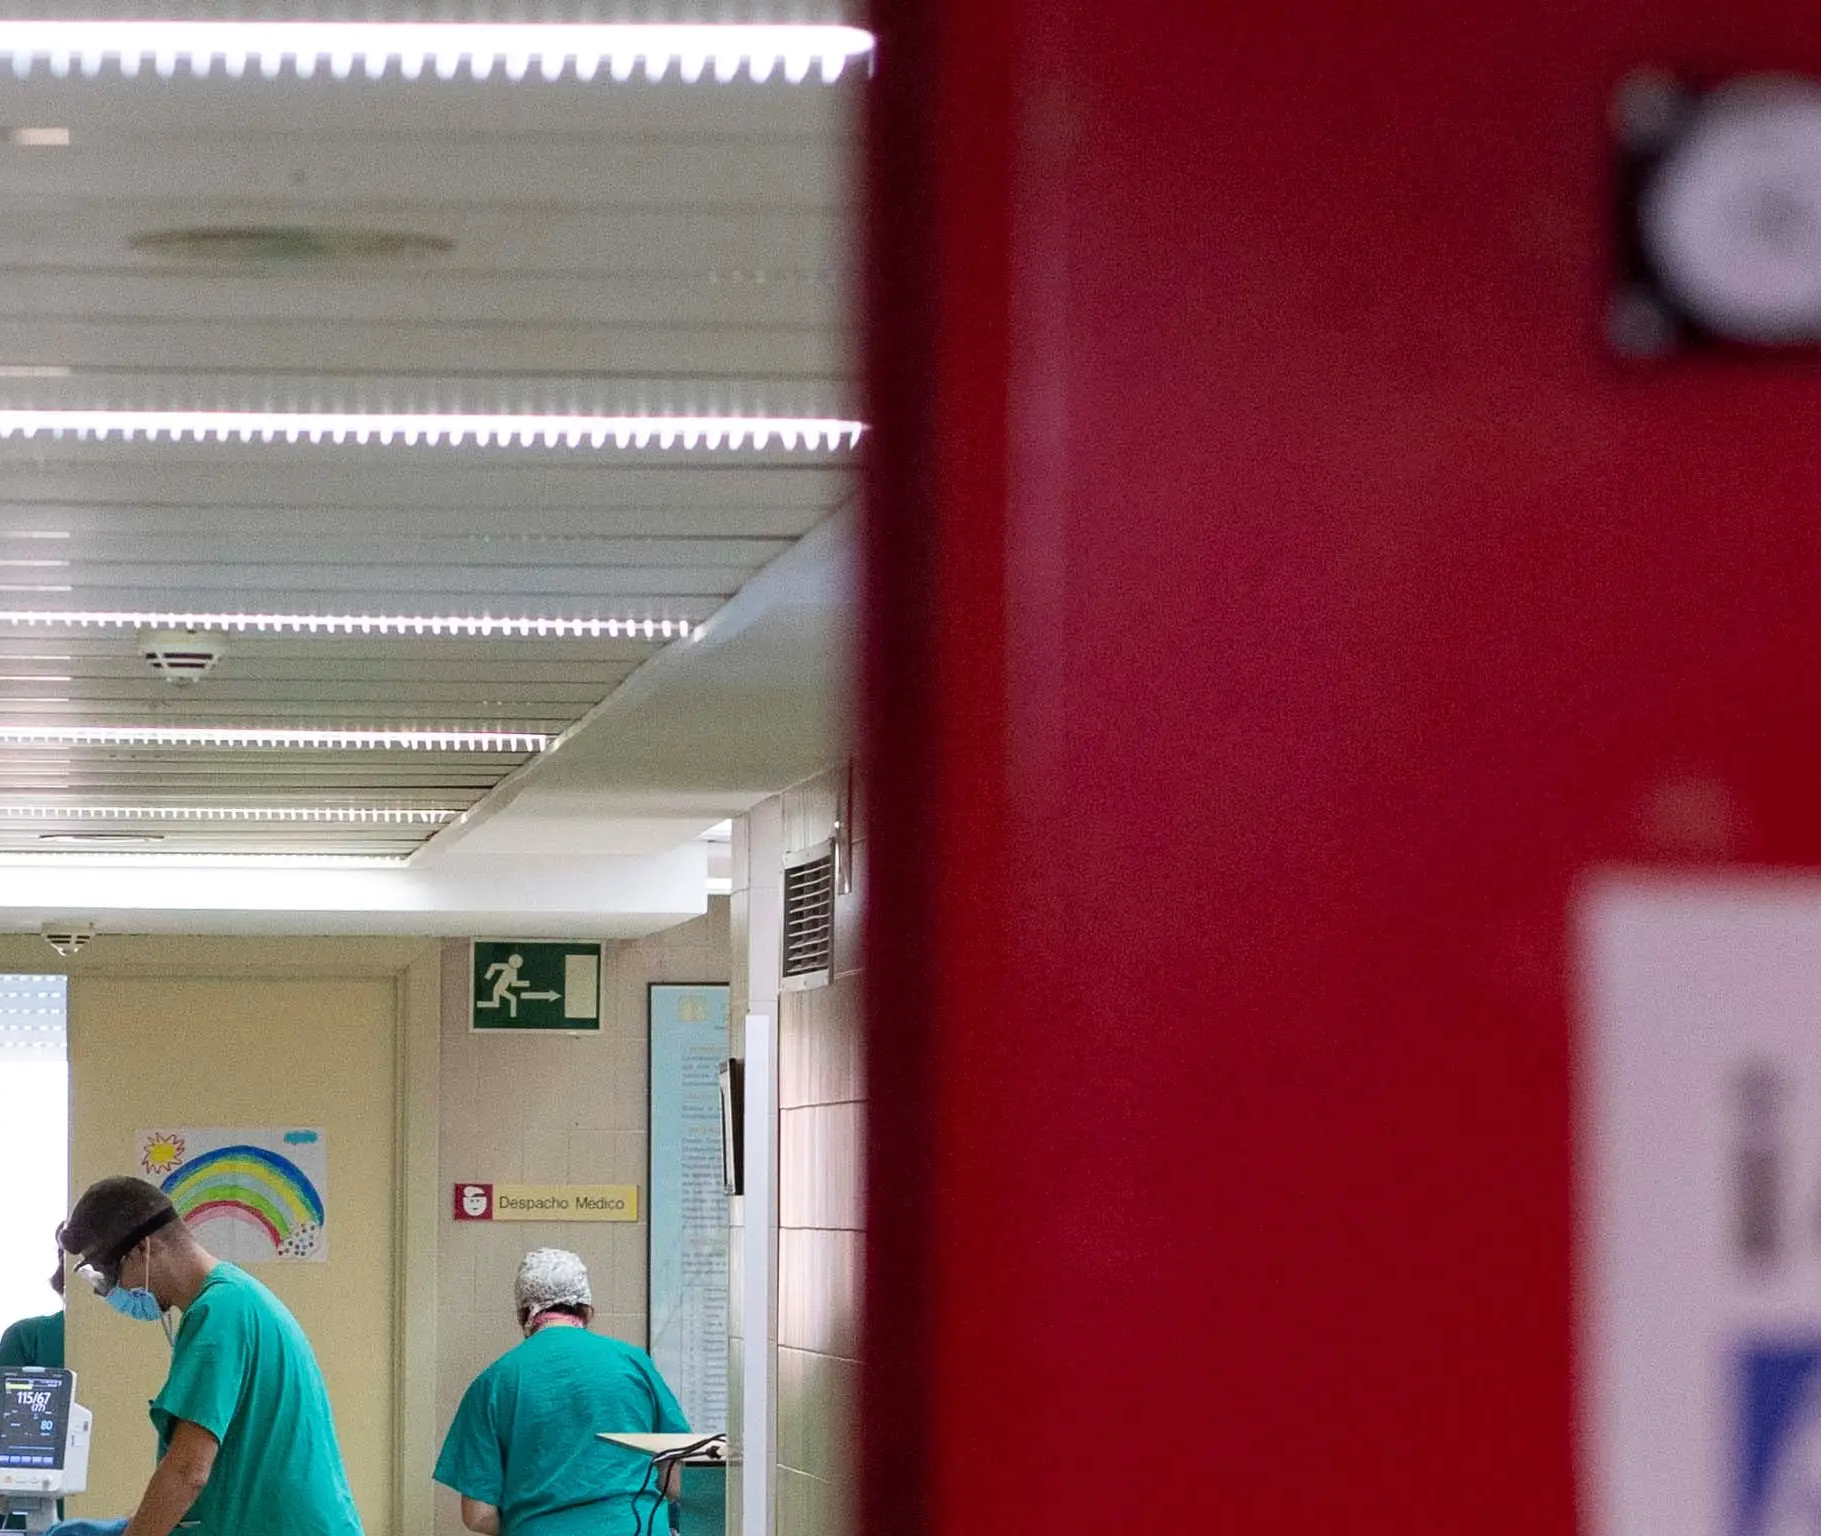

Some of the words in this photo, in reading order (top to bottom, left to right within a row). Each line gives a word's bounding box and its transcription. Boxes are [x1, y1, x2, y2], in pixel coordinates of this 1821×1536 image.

[499, 1195, 569, 1211] Despacho
[17, 1391, 51, 1405] 115/67
[40, 1420, 53, 1431] 80
